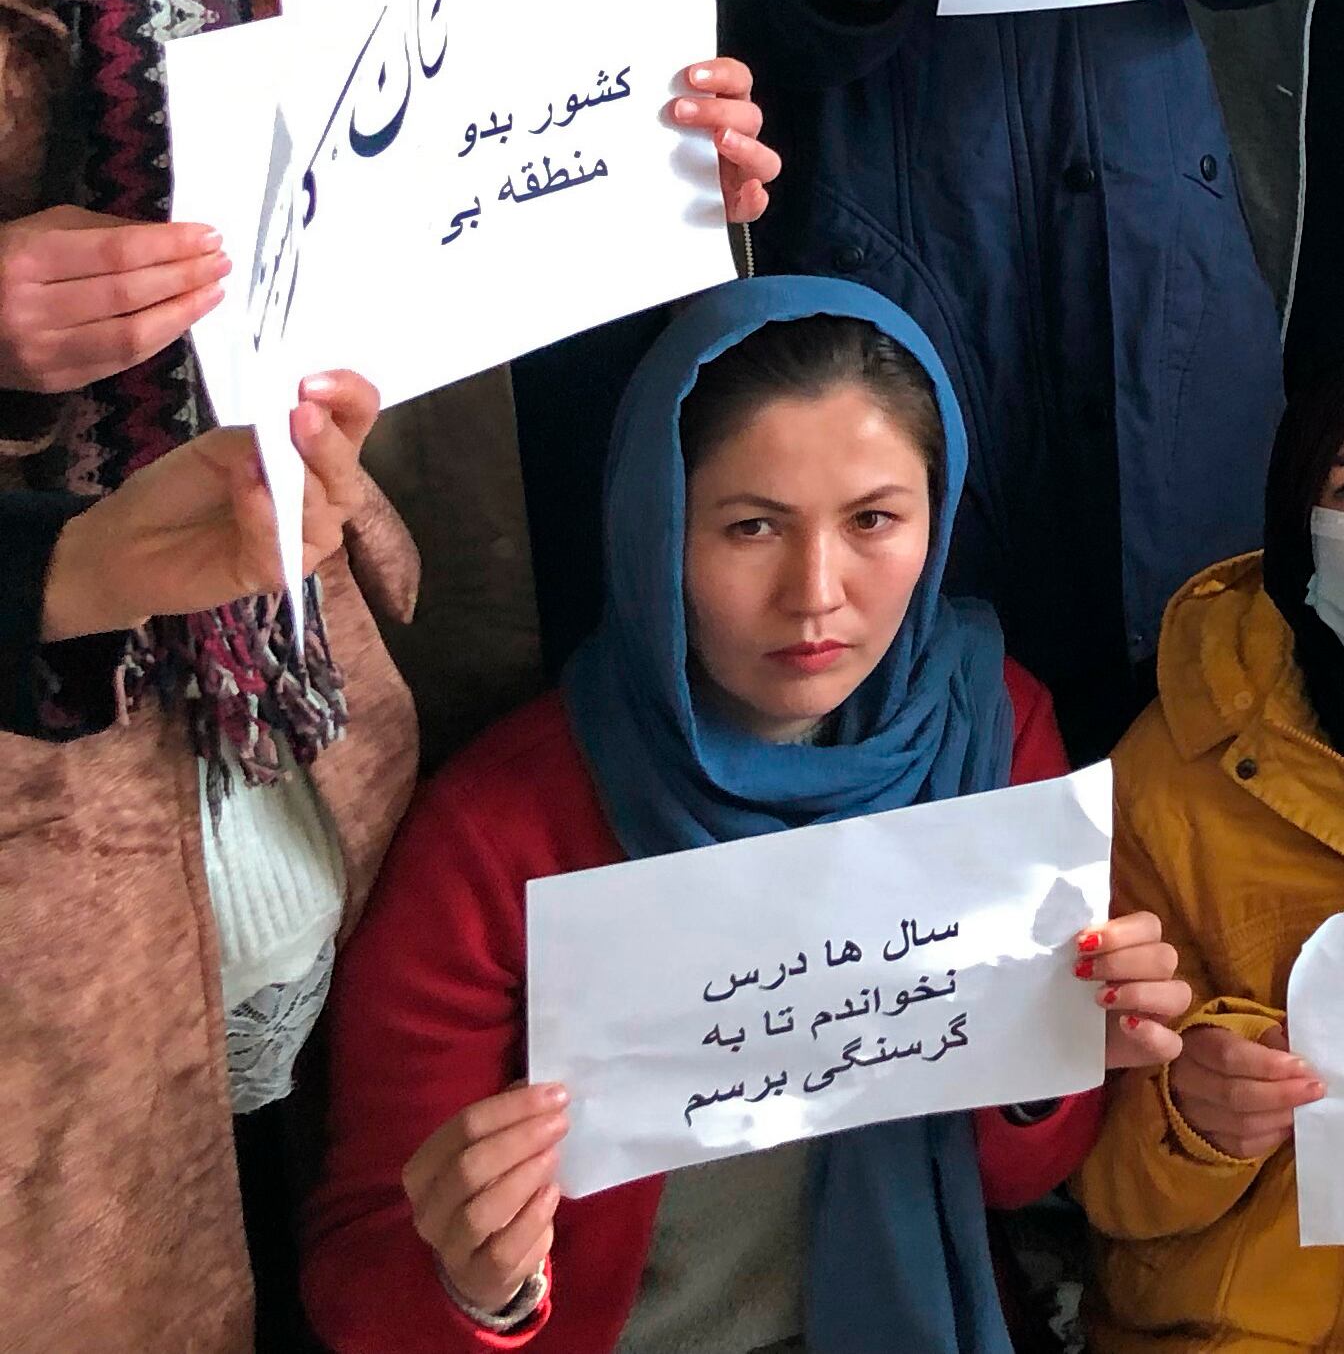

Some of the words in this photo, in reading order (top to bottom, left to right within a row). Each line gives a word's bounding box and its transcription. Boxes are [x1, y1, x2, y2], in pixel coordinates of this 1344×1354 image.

[528, 65, 631, 135] کشور
[457, 111, 513, 158] بدو
[497, 150, 609, 204] منطقه
[824, 939, 863, 968] ها
[882, 918, 959, 962] سال
[702, 951, 808, 1003] درس
[763, 1006, 794, 1037] تا
[810, 968, 957, 1041] نخواندم
[701, 1023, 746, 1053] به
[802, 1010, 969, 1094] گرسنگی
[683, 1069, 788, 1128] برسم
